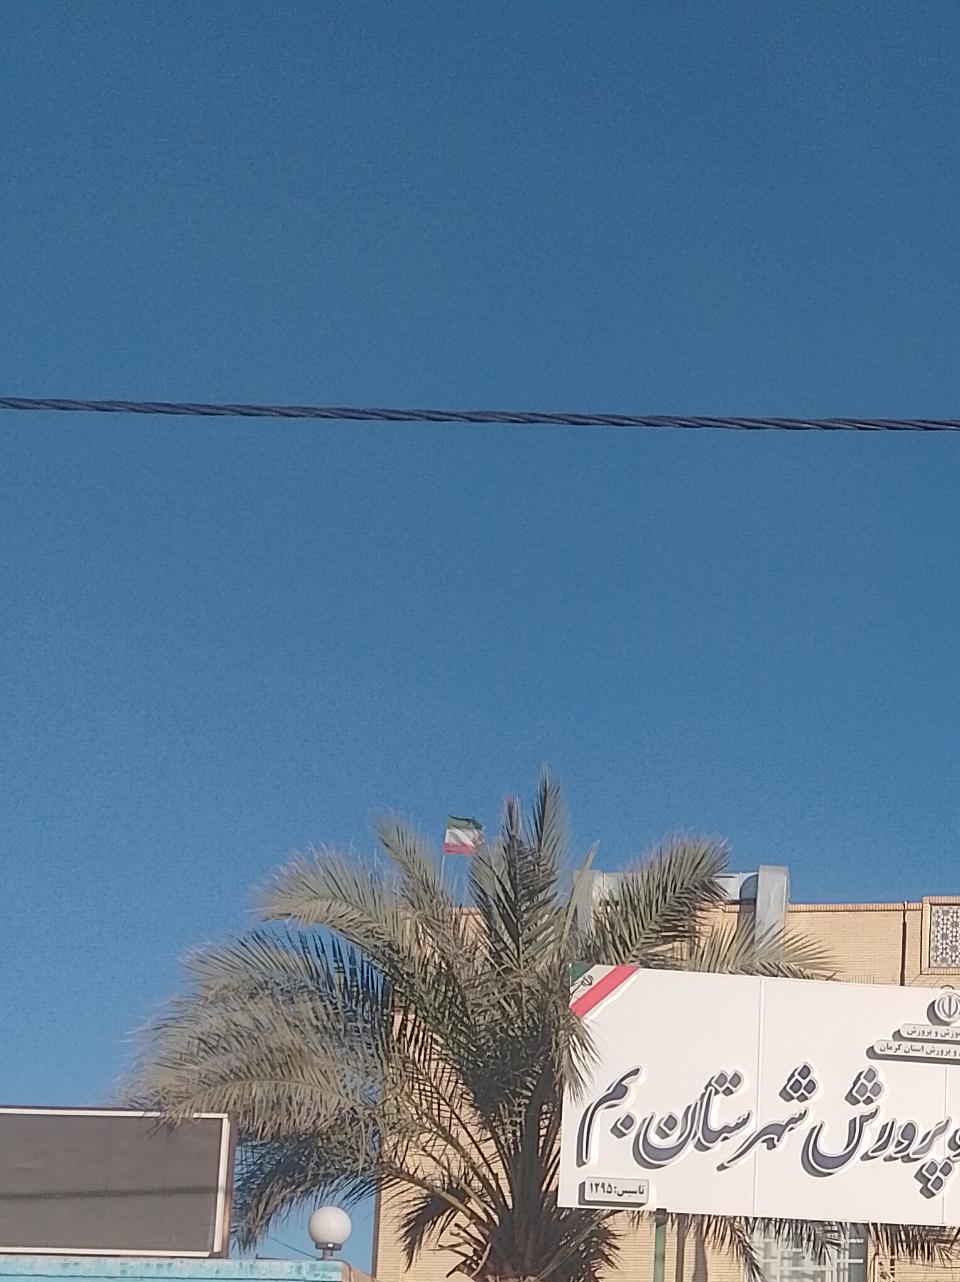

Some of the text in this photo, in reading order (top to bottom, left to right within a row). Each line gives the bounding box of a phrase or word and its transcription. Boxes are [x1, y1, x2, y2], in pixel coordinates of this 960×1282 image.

[906, 1027, 932, 1038] پرورش
[879, 1042, 902, 1053] کرمان
[903, 1044, 924, 1055] استان
[926, 1046, 951, 1057] پرورش
[577, 1066, 641, 1167] بم
[633, 1062, 817, 1171] شهرستان
[801, 1065, 953, 1199] پرورش
